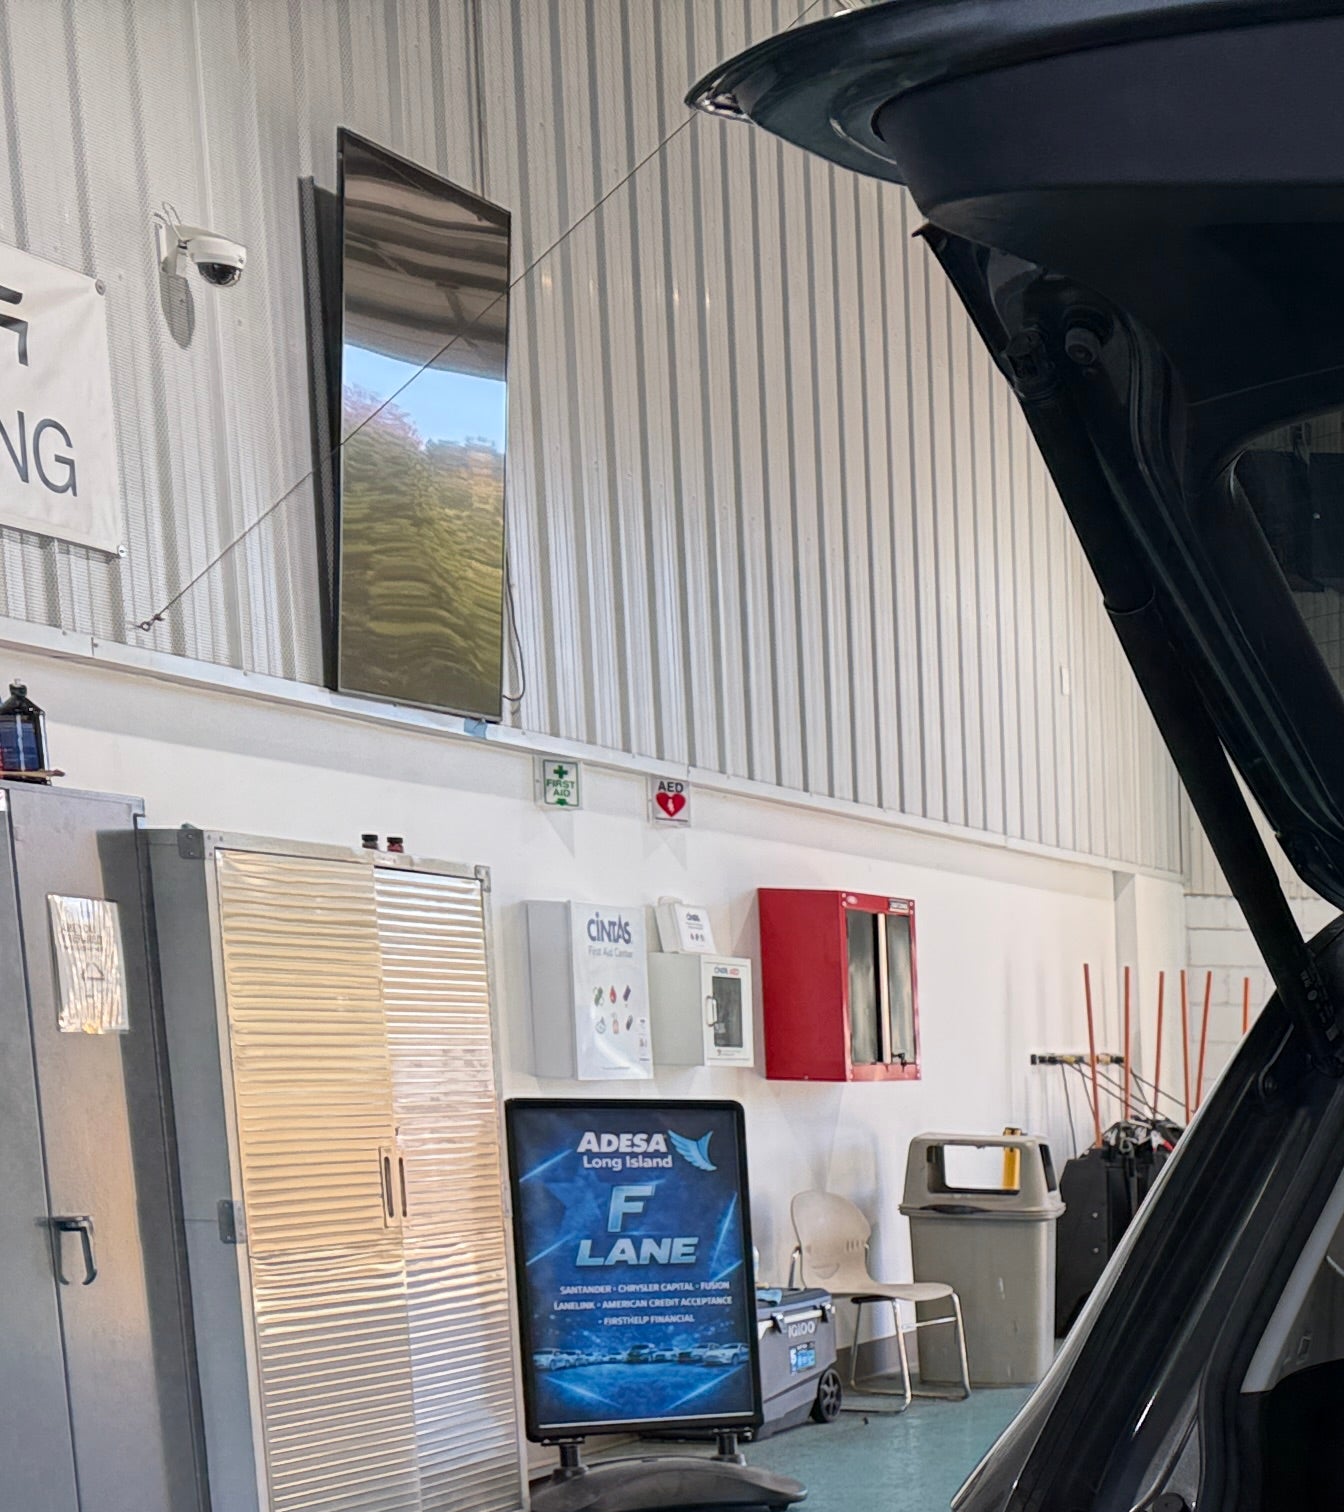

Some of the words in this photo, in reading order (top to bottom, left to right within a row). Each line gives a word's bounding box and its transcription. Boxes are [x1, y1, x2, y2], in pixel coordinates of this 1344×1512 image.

[546, 778, 575, 789] FIRST
[658, 780, 684, 794] AED
[552, 788, 571, 798] AID
[576, 1131, 668, 1153] ADESA
[583, 1154, 623, 1172] Long
[625, 1154, 673, 1169] Island
[607, 1184, 656, 1233] F
[575, 1236, 699, 1267] LANE
[560, 1285, 612, 1295] SANTANDER
[617, 1283, 660, 1293] CHRYSLER
[661, 1282, 694, 1292] CAPITAL
[602, 1300, 648, 1310] AMERICAN
[649, 1299, 680, 1308] CREDIT
[680, 1296, 732, 1307] ACCEPTANCE
[650, 1314, 695, 1324] FINANCIAL
